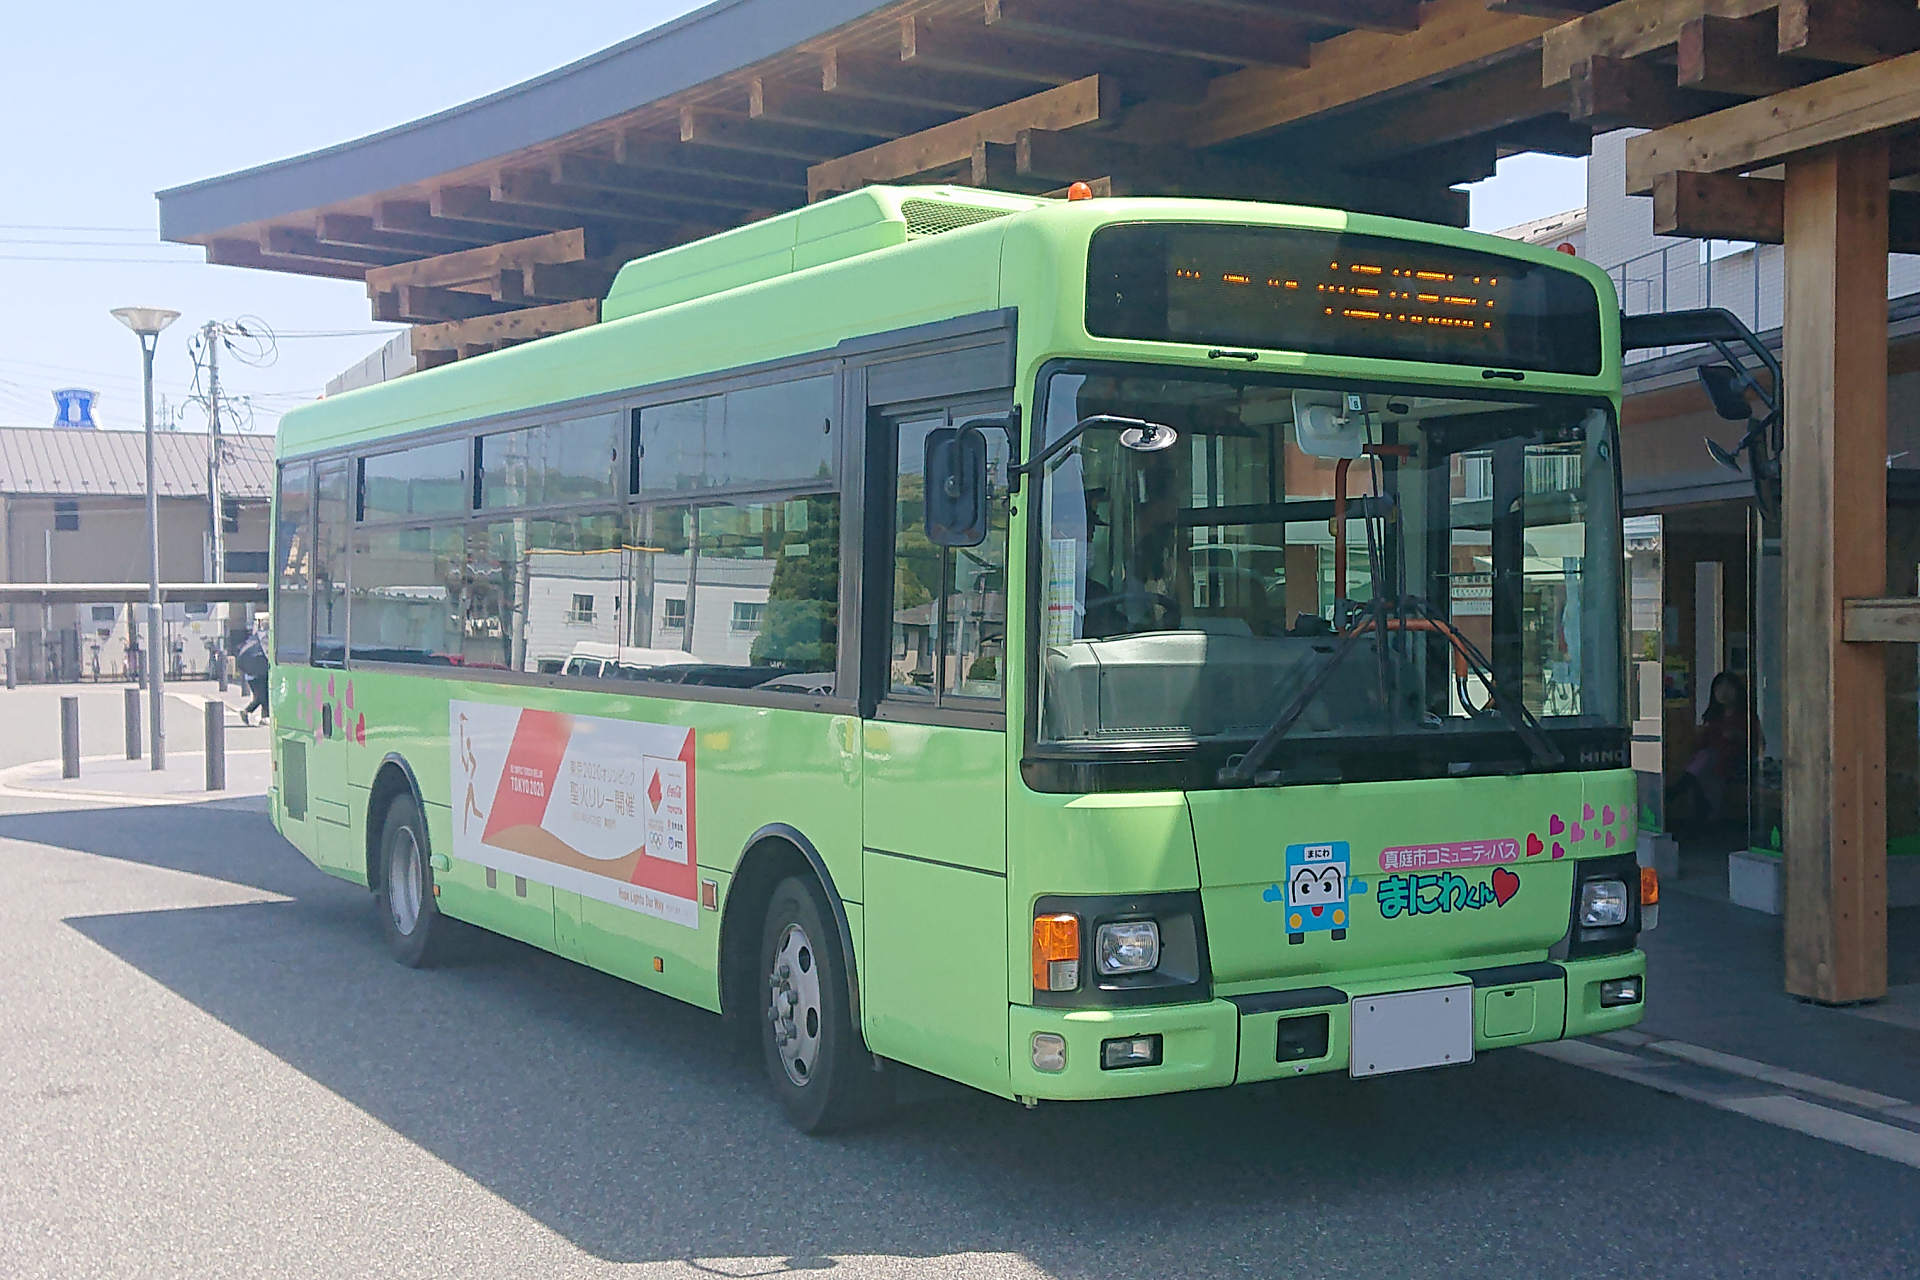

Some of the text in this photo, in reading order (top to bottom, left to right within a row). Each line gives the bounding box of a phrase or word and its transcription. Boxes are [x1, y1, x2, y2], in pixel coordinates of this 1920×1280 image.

[1580, 751, 1624, 764] HINO
[510, 776, 544, 797] TOKYO 2020
[1307, 848, 1330, 859] まにわ
[1384, 842, 1517, 869] 真庭市コミュニティバス
[1377, 872, 1496, 919] まにわくん
